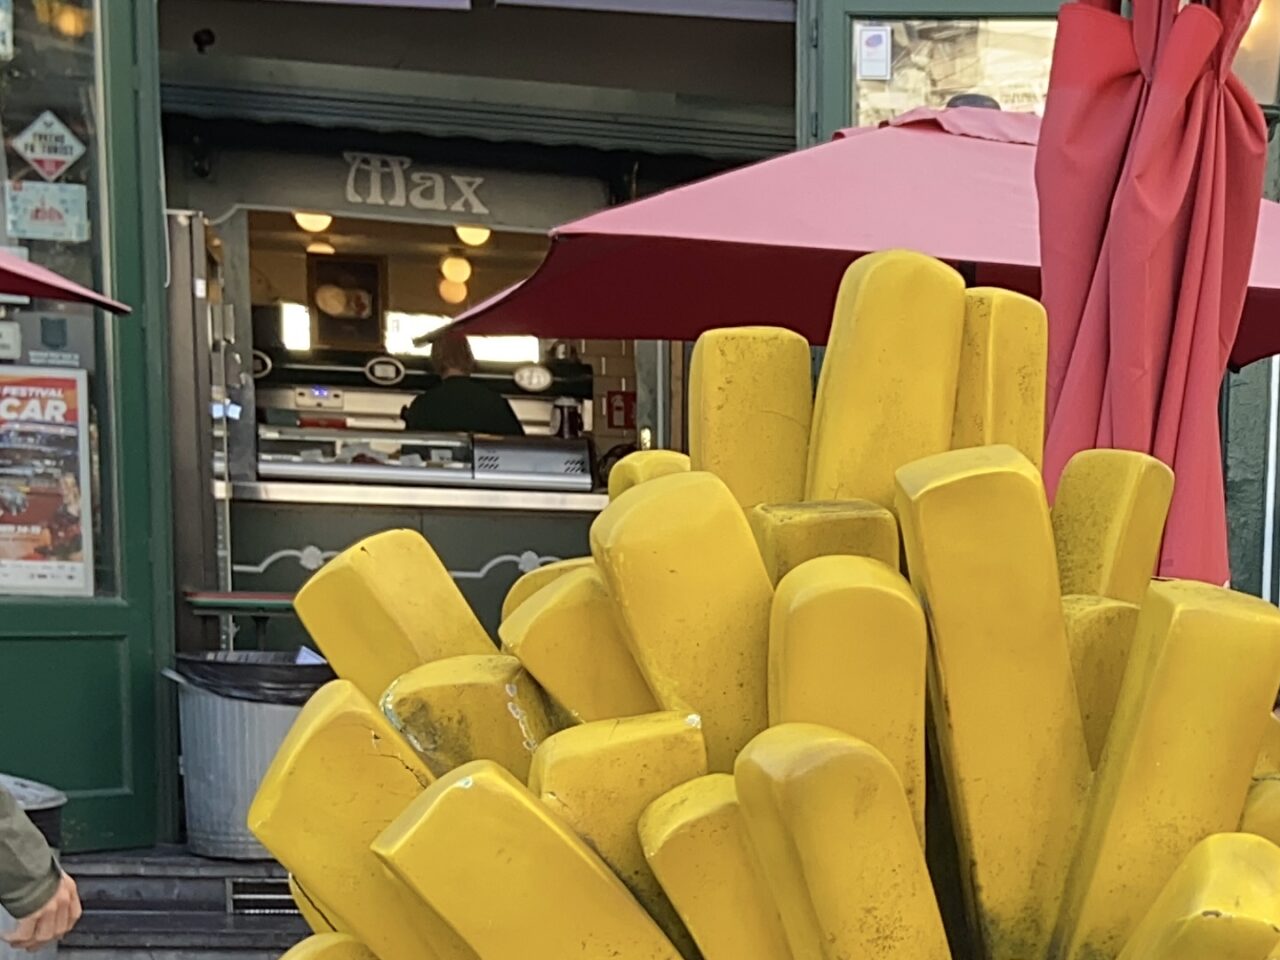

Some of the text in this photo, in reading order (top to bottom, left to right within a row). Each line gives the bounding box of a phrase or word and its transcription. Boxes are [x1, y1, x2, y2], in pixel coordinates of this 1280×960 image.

[343, 152, 490, 214] Max
[2, 385, 64, 399] FESTIVAL
[0, 397, 67, 422] CAR
